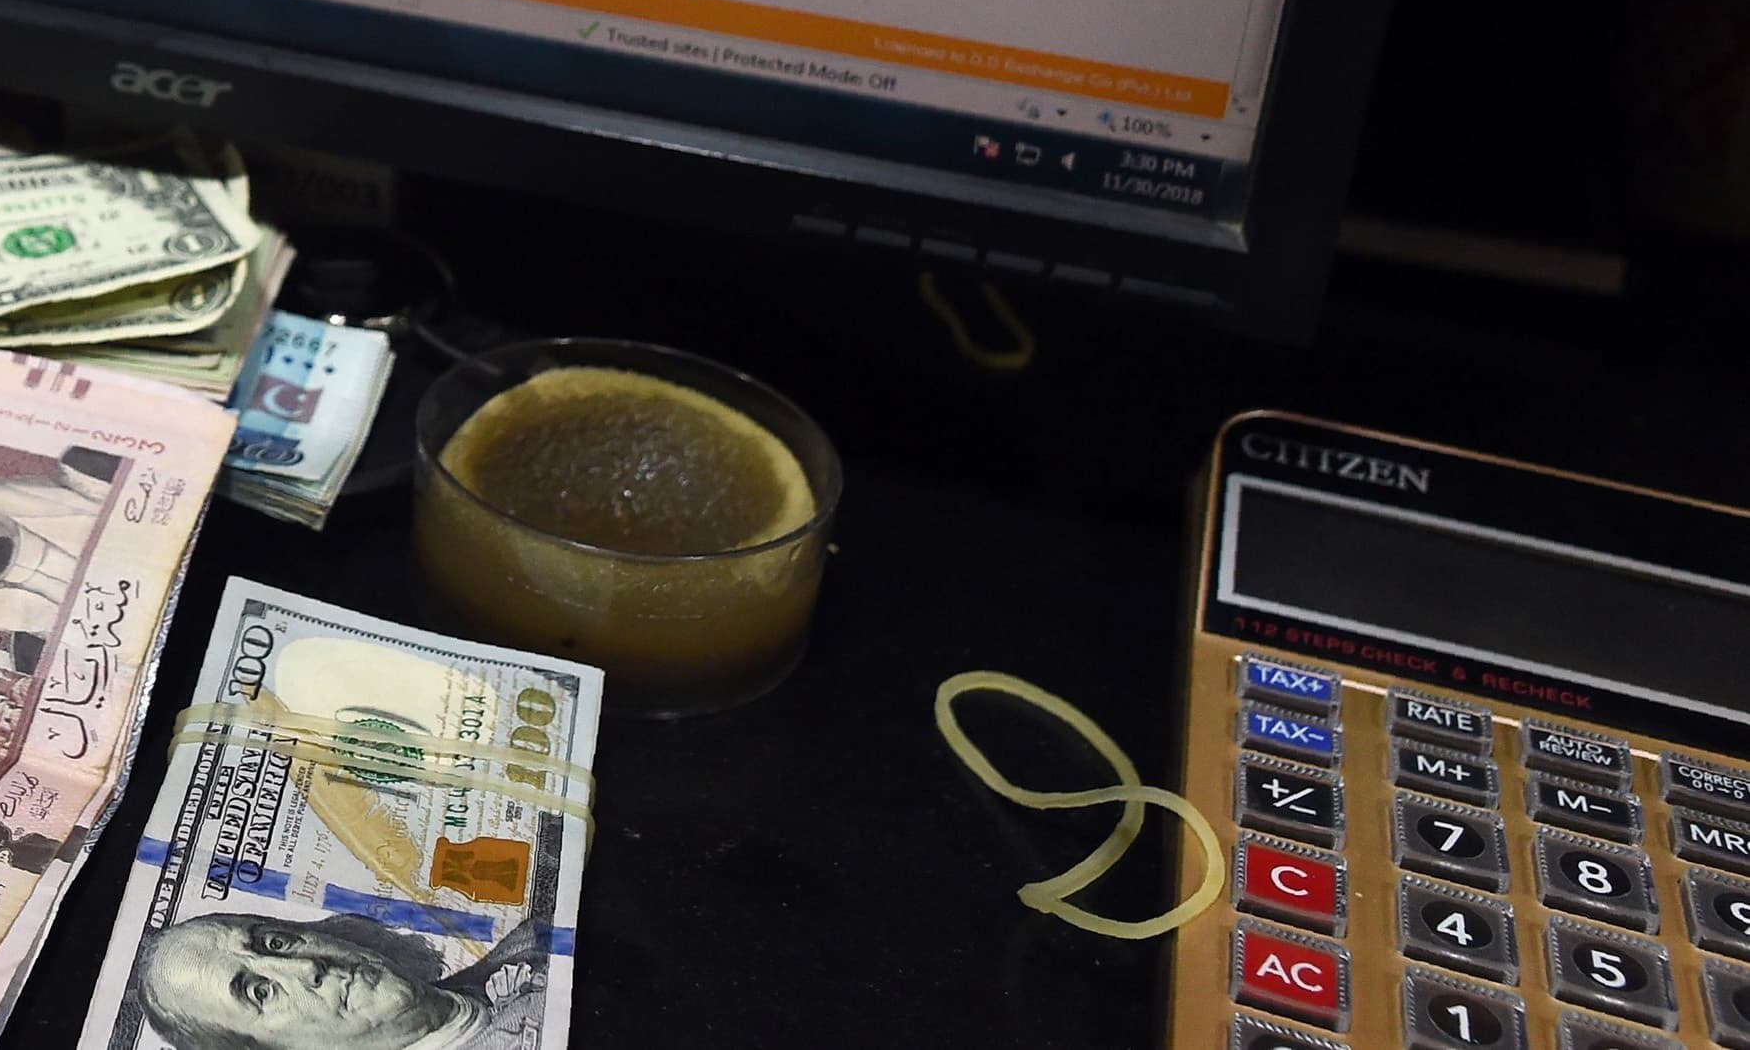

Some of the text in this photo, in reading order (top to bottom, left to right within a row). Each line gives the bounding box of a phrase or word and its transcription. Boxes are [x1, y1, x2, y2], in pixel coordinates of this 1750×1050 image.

[607, 25, 899, 94] Trusted sites Protected Mode: Off
[110, 61, 233, 107] acer
[1120, 115, 1174, 140] 100%
[1161, 159, 1196, 180] PM
[1102, 172, 1205, 205] 11/30/2018
[1239, 432, 1433, 495] CITIZEN
[229, 624, 274, 700] 100
[1254, 663, 1325, 694] TAX+
[1285, 628, 1592, 708] STEPS CHECK RECHECK
[1254, 713, 1326, 744] TAX-
[1407, 702, 1473, 733] RATE
[1539, 740, 1613, 767] REVIEW
[1546, 734, 1603, 755] AUTO
[1416, 755, 1471, 782] M+
[1433, 820, 1464, 852] 7
[1690, 823, 1750, 856] MR
[1270, 864, 1309, 897] C
[1578, 859, 1613, 894] 8
[1436, 911, 1473, 946] 4
[1255, 952, 1324, 993] AC
[1590, 949, 1627, 989] 5
[1446, 1004, 1470, 1043] 1
